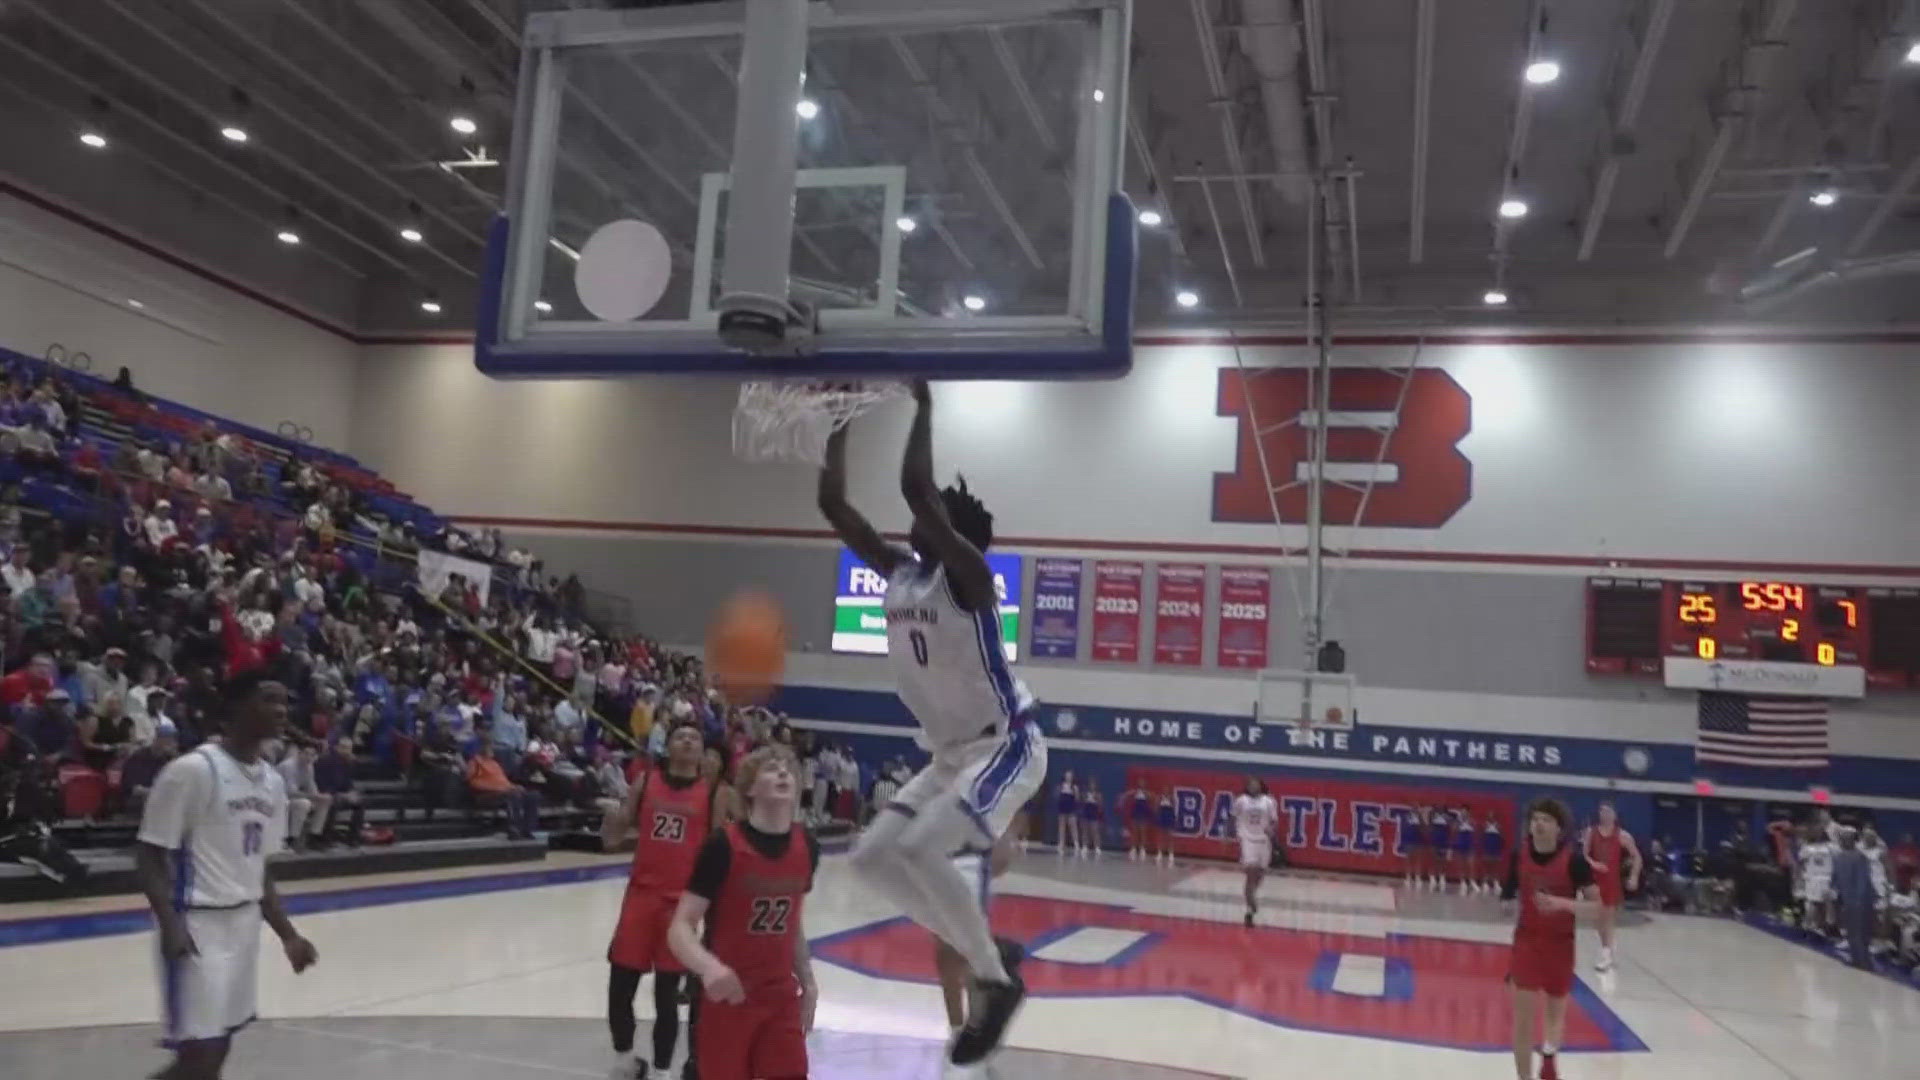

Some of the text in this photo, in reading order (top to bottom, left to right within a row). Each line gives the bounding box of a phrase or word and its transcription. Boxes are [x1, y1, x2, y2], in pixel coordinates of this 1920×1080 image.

[1211, 367, 1472, 528] B
[1036, 595, 1074, 611] 2001
[1095, 597, 1138, 614] 2023
[1158, 601, 1200, 617] 2024
[1680, 594, 1716, 622] 25
[1742, 583, 1803, 611] 5:54
[1222, 603, 1266, 620] 2025
[1837, 600, 1856, 627] 7
[1781, 619, 1798, 641] 2
[909, 628, 928, 668] 0
[1699, 637, 1715, 659] 0
[1817, 643, 1835, 666] 0
[1114, 717, 1562, 765] HOME OF THE PANTHERS
[652, 811, 687, 843] 23
[749, 897, 791, 935] 22
